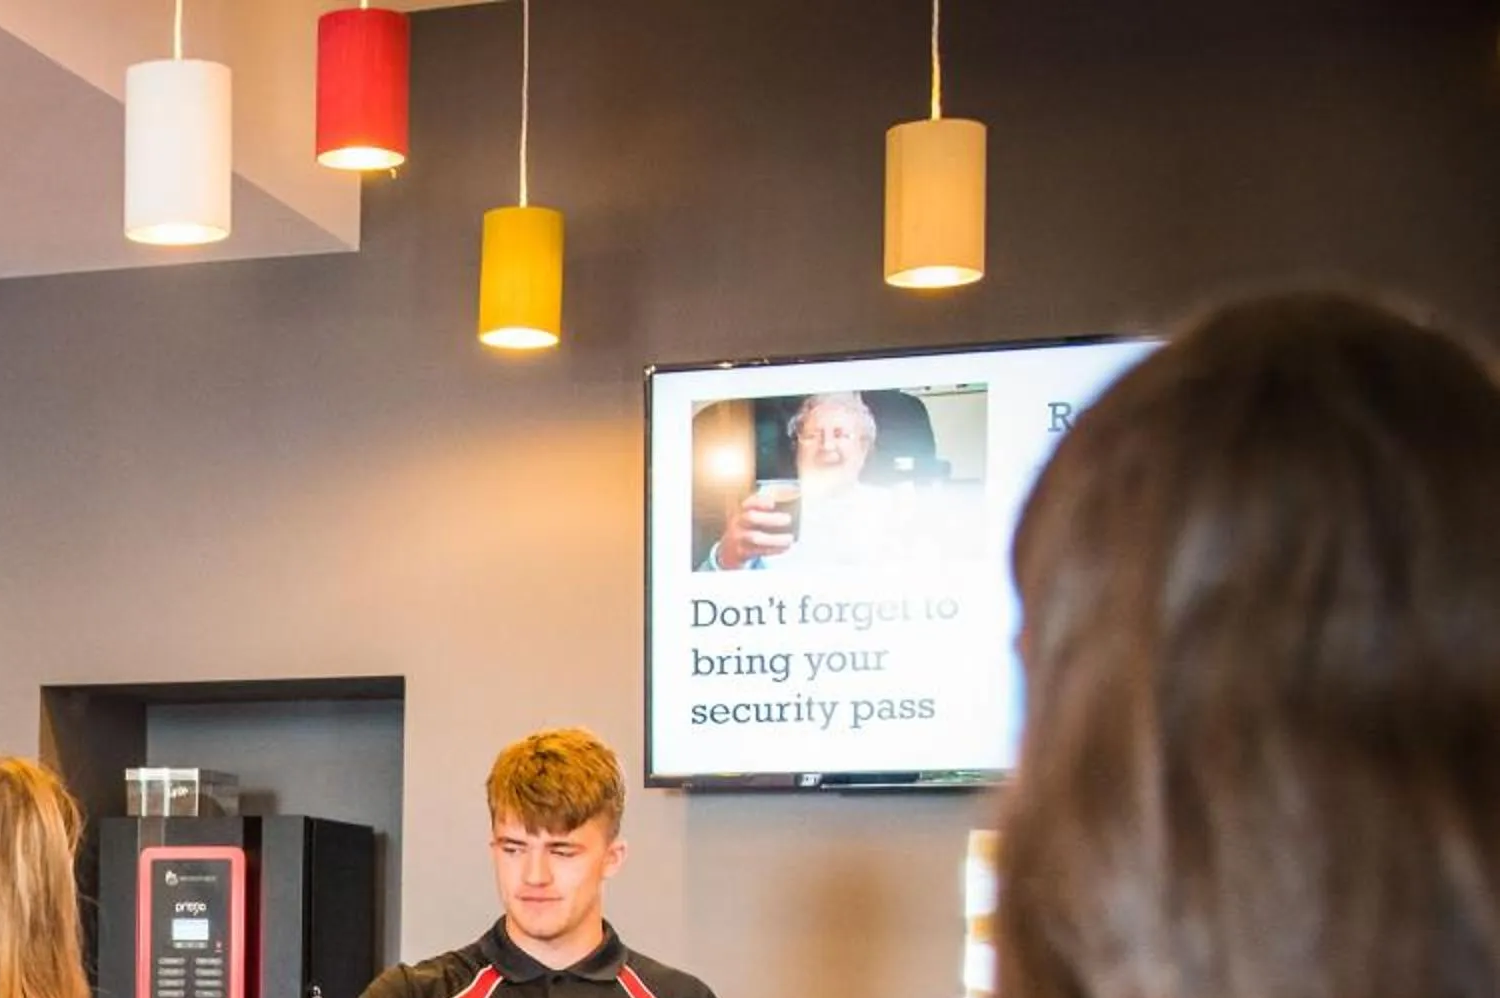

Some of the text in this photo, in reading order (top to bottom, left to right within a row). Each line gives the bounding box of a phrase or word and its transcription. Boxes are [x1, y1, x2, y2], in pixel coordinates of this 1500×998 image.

[690, 595, 959, 631] Don't forget to
[691, 647, 890, 683] bring your
[691, 692, 937, 730] security pass
